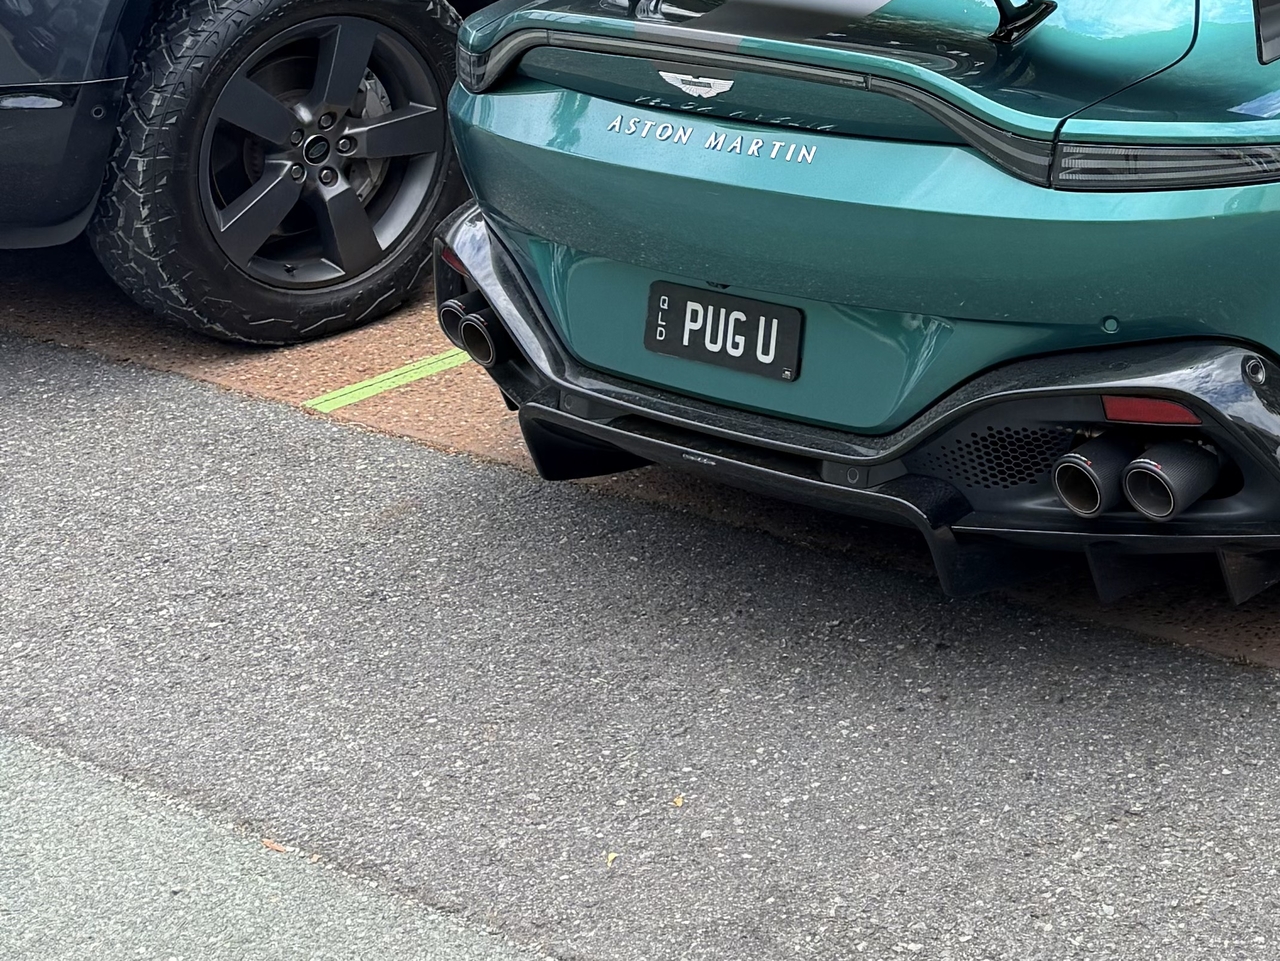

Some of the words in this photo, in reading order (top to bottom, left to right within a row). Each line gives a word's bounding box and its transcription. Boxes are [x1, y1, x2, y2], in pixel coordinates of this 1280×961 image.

[606, 114, 694, 145] ASTON
[704, 131, 818, 164] MARTIN
[682, 300, 747, 358] PUG
[756, 315, 778, 364] U
